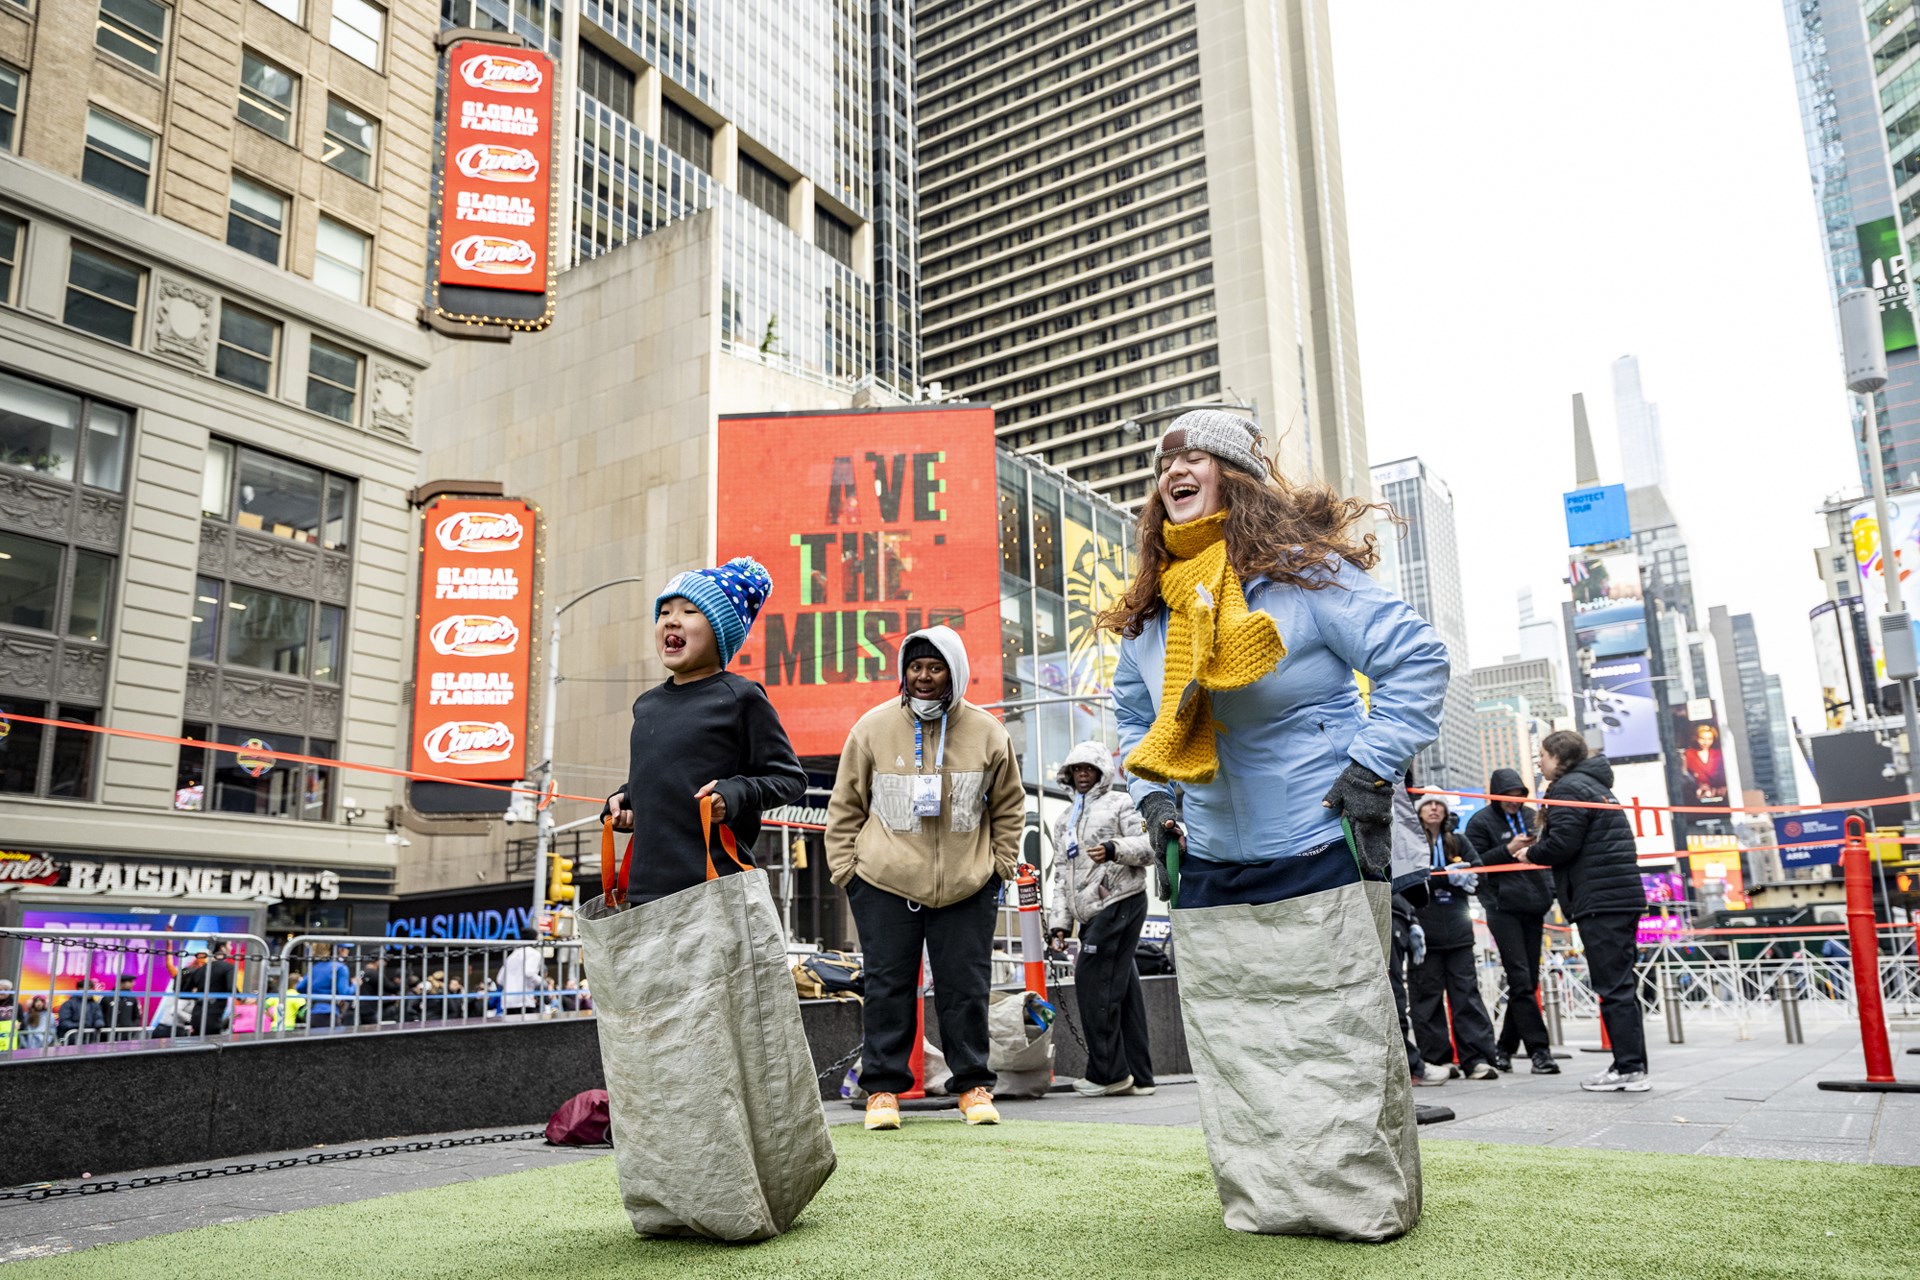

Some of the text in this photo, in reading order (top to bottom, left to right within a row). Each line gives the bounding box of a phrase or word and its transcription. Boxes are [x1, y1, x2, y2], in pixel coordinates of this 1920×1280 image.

[464, 54, 540, 88] Cane's
[462, 101, 538, 124] GLOBAL
[461, 116, 539, 136] FLAGSHIP
[460, 144, 537, 178] Cane's
[457, 191, 535, 214] GLOBAL
[456, 207, 535, 227] FLAGSHIP
[455, 235, 534, 270] Cane's
[1567, 491, 1605, 504] PROTECT
[1569, 503, 1592, 514] YOUR
[440, 512, 519, 550] Cane's
[437, 567, 519, 586] GLOBAL
[790, 531, 914, 606] THE
[435, 584, 519, 600] FLAGSHIP
[435, 615, 515, 655] Cane's
[764, 608, 966, 687] MUS
[431, 672, 514, 690] GLOBAL
[429, 690, 515, 705] FLAGSHIP
[428, 721, 512, 763] Cane's
[1786, 851, 1811, 861] AREA
[67, 860, 340, 900] RAISING CANE'S
[431, 906, 536, 940] SUNDAY
